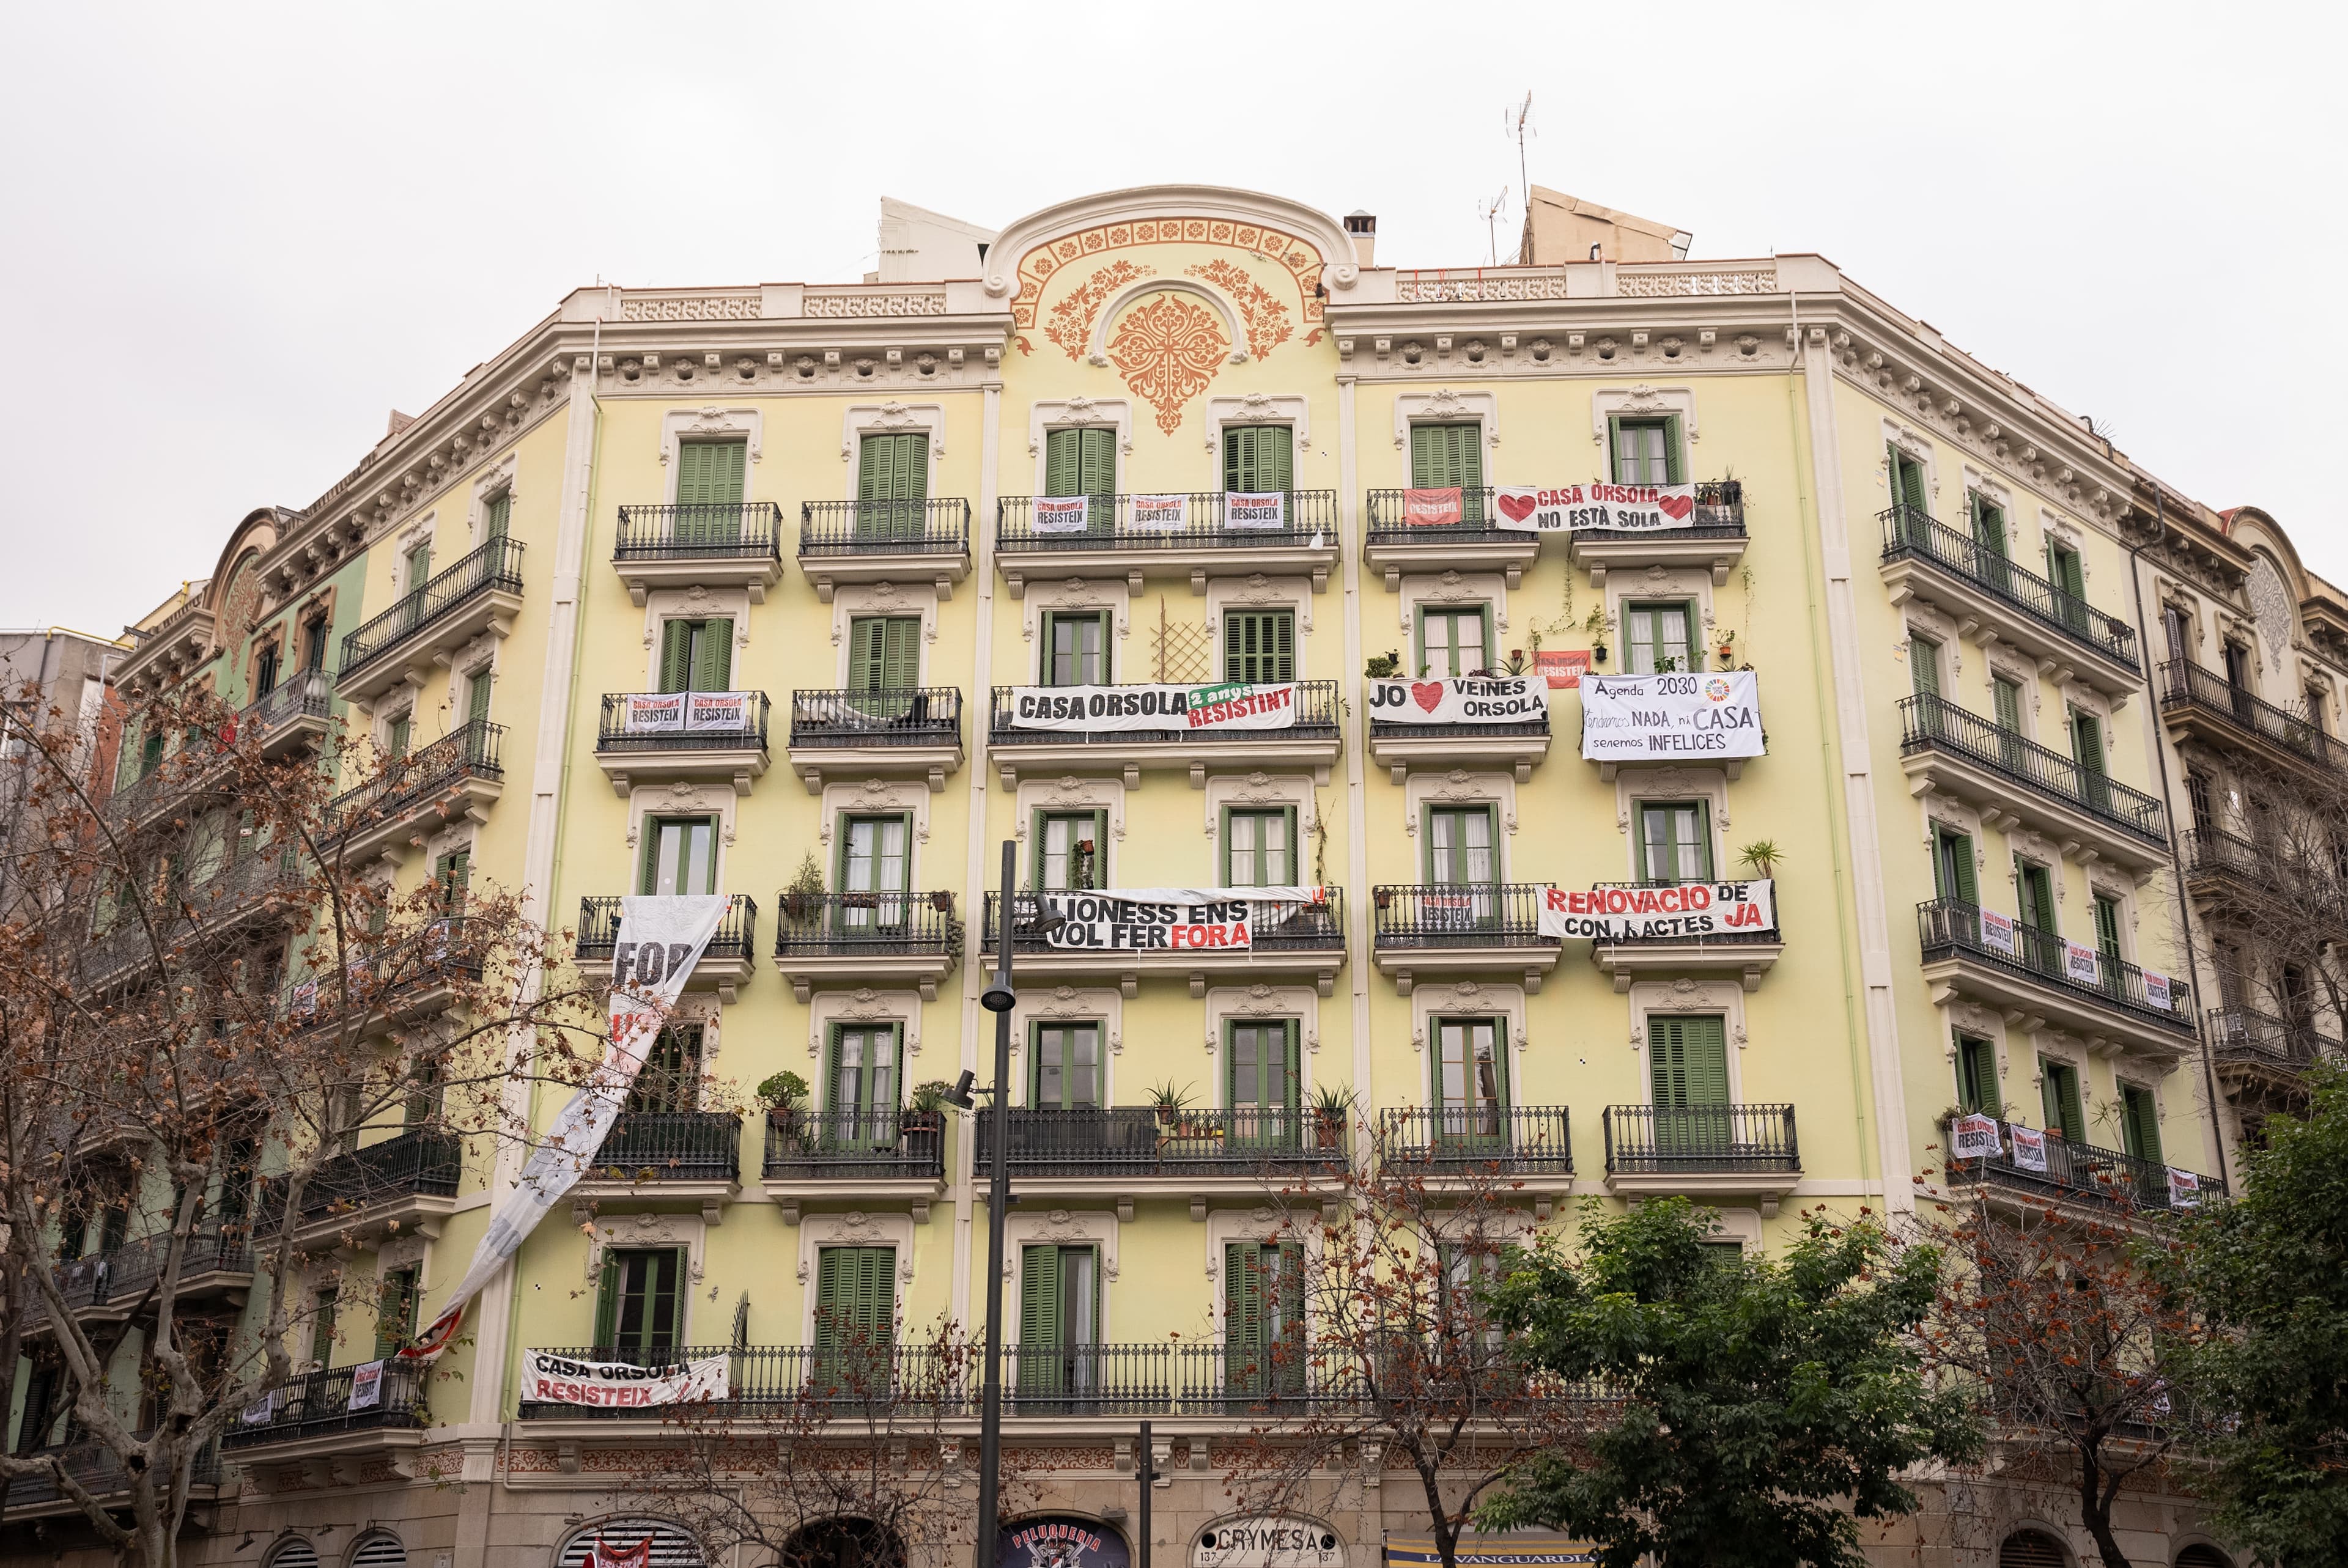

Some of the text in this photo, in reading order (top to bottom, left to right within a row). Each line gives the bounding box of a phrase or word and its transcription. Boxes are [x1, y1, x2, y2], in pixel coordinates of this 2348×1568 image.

[1135, 500, 1182, 509] CASA ORSOLA
[1231, 498, 1278, 507] CASA ORSOLA
[1537, 484, 1659, 506] CASA ORSOLA
[1038, 501, 1083, 512] CASA ORSOLA
[1135, 509, 1181, 522] RESISTEIX
[1231, 507, 1278, 520] RESISTEIX
[1038, 510, 1083, 525] RESISTEIX
[1537, 506, 1661, 529] NO ESTÀ SOLA
[1537, 665, 1586, 677] RESISTEIX
[1191, 685, 1253, 705] 2 anys
[1369, 684, 1406, 708] JO
[1594, 676, 1698, 700] Agenda 2030
[633, 699, 679, 709] CASA ORSOLA
[695, 698, 742, 707] CASA ORSOLA
[1019, 691, 1188, 720] CASA ORSOLA
[1187, 686, 1292, 728] RESISTINT
[1464, 694, 1545, 717] ORSOLA
[632, 707, 679, 723] RESISTEIX
[693, 707, 741, 721] RESISTEIX
[1678, 715, 1691, 726] ni
[1693, 705, 1754, 731] CASA
[1593, 733, 1726, 751] seremos INFELICES
[1718, 885, 1749, 902] DE
[1188, 899, 1248, 924] ENS
[1724, 903, 1764, 927] JA
[1050, 922, 1250, 949] VOL FER FORA
[1957, 1121, 1976, 1133] CASA
[536, 1355, 591, 1378] CASA
[536, 1379, 653, 1405] RESISTEIX
[1012, 1524, 1101, 1552] PELUQUERIA
[1217, 1529, 1318, 1550] CRYMESA
[1200, 1551, 1216, 1562] 137
[1318, 1551, 1335, 1562] 137
